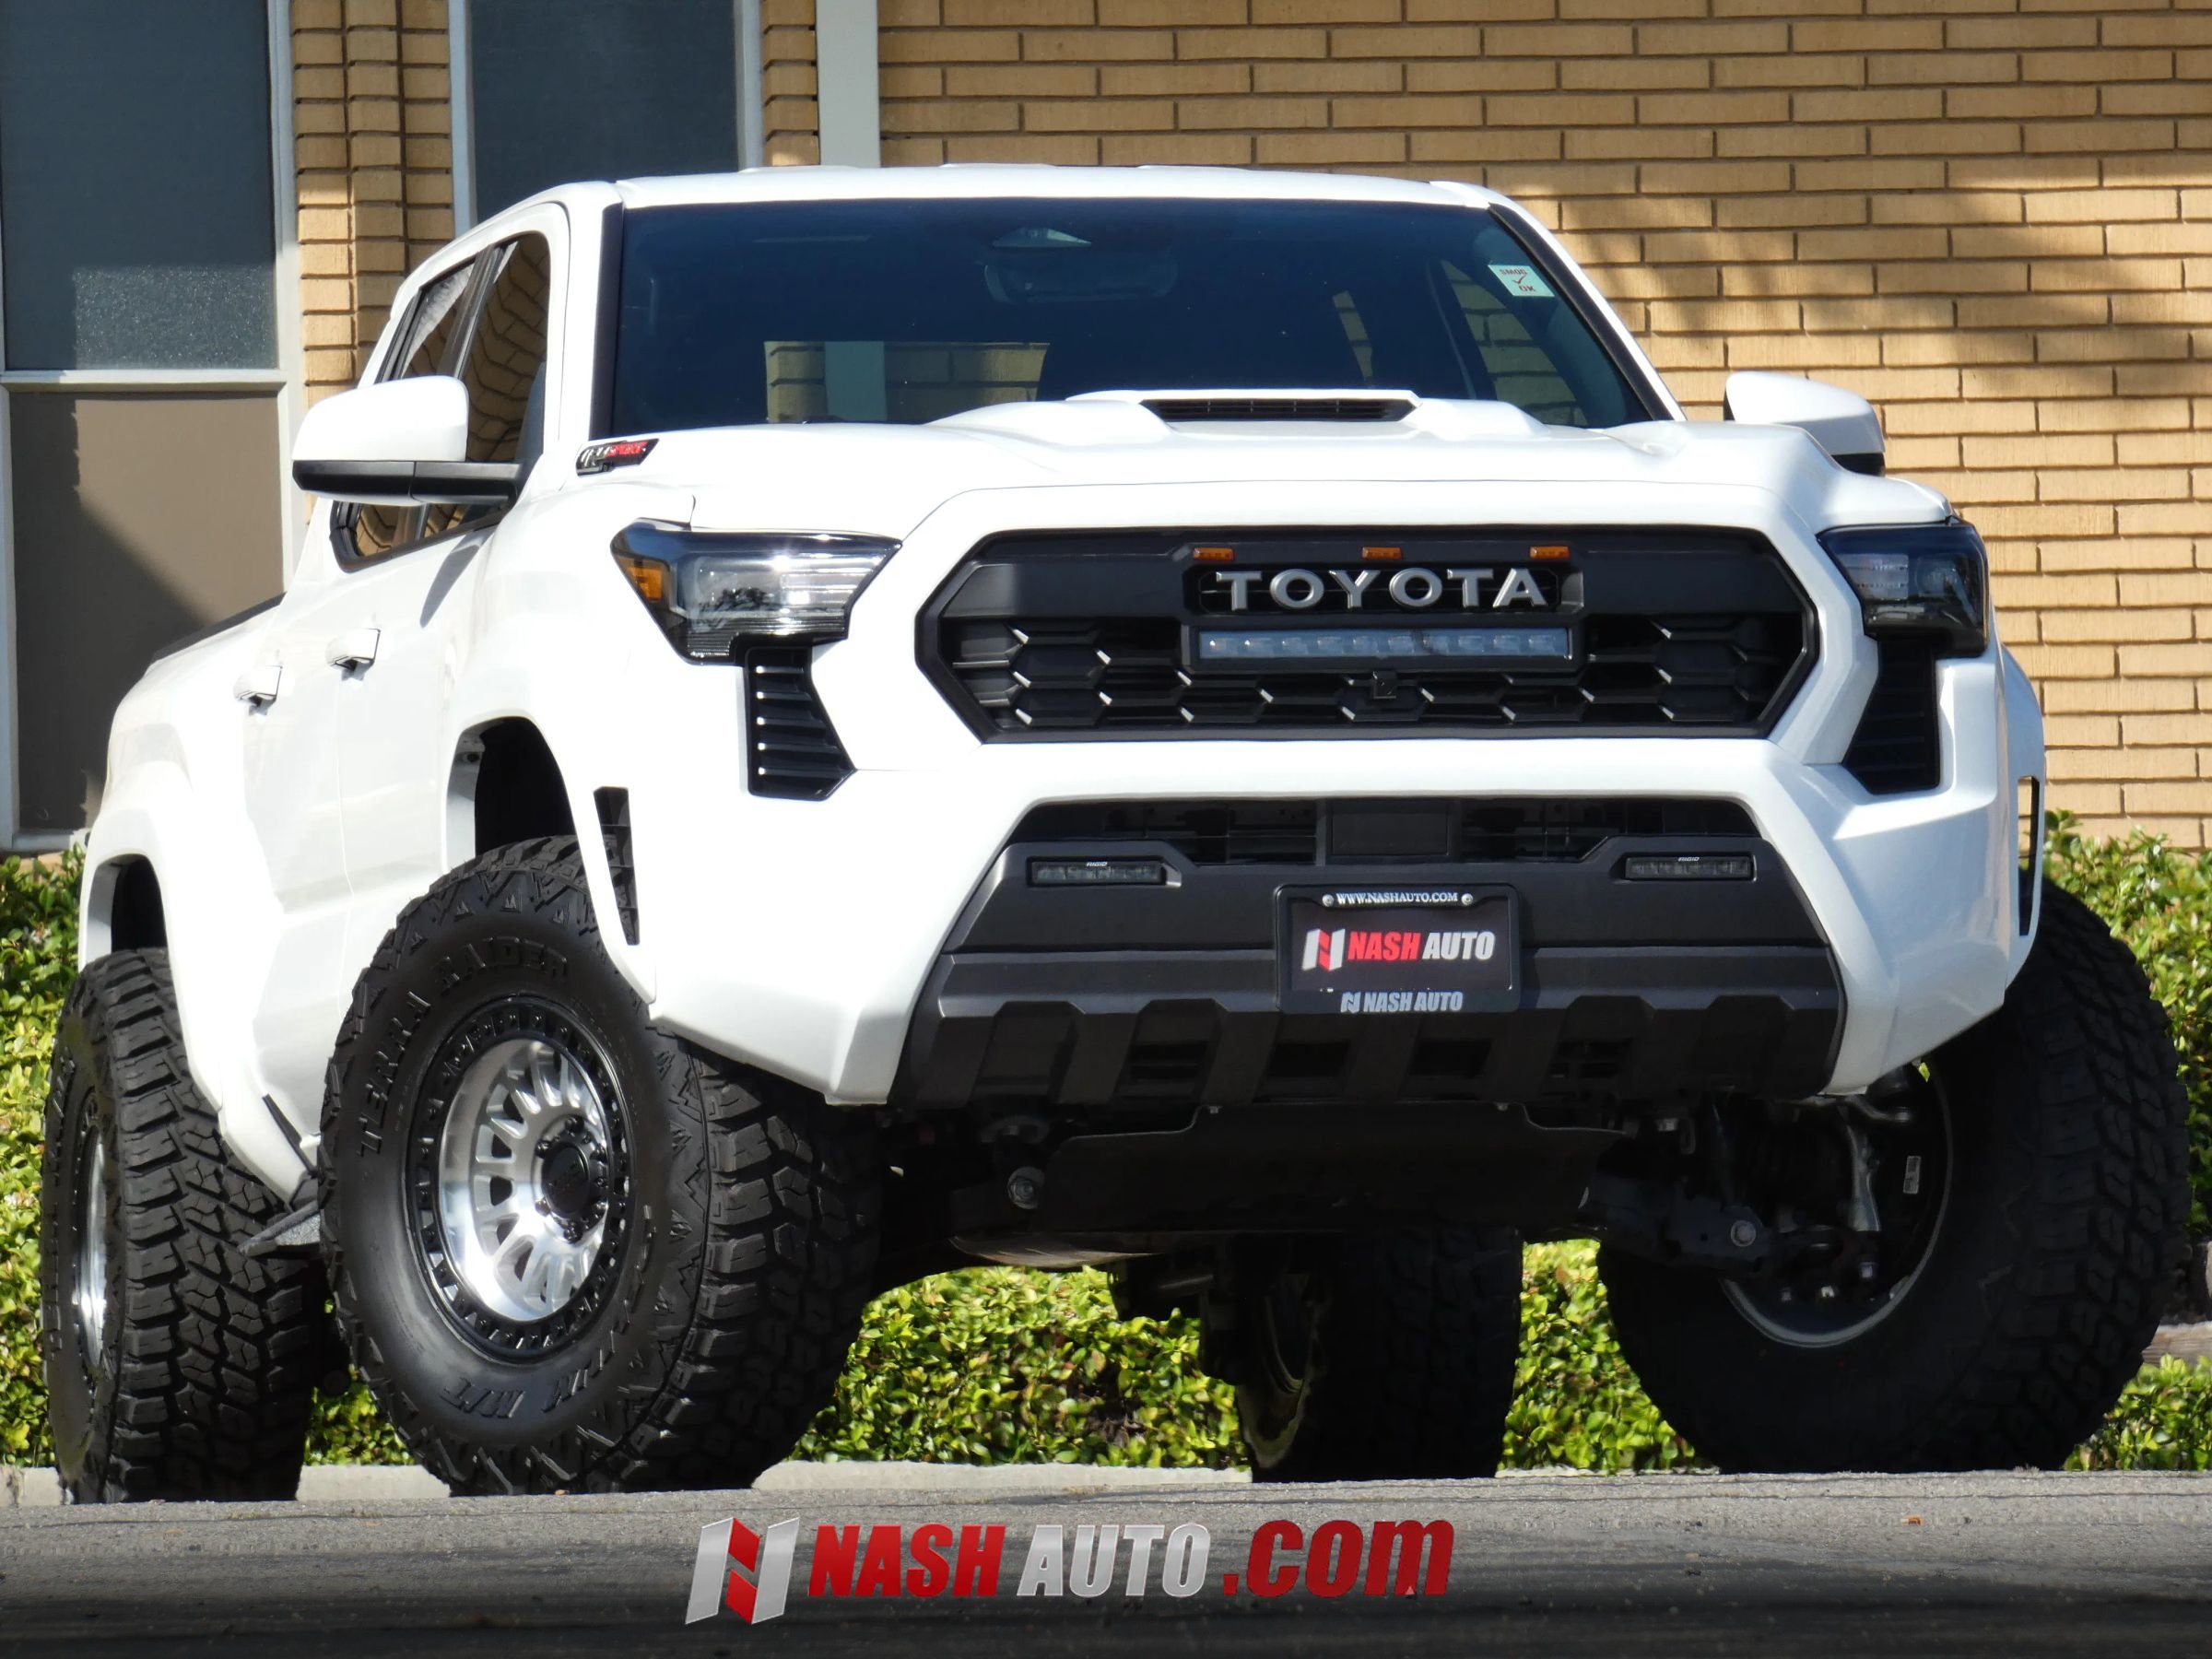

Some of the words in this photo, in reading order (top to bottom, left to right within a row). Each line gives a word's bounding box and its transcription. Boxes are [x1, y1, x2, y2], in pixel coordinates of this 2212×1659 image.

[1215, 567, 1548, 611] TOYOTA
[1335, 892, 1458, 904] WWW.NASHAUTO.COM
[1347, 931, 1421, 961] NASH
[1422, 931, 1496, 960] AUTO
[1363, 992, 1413, 1013] NASH
[1414, 992, 1465, 1012] AUTO
